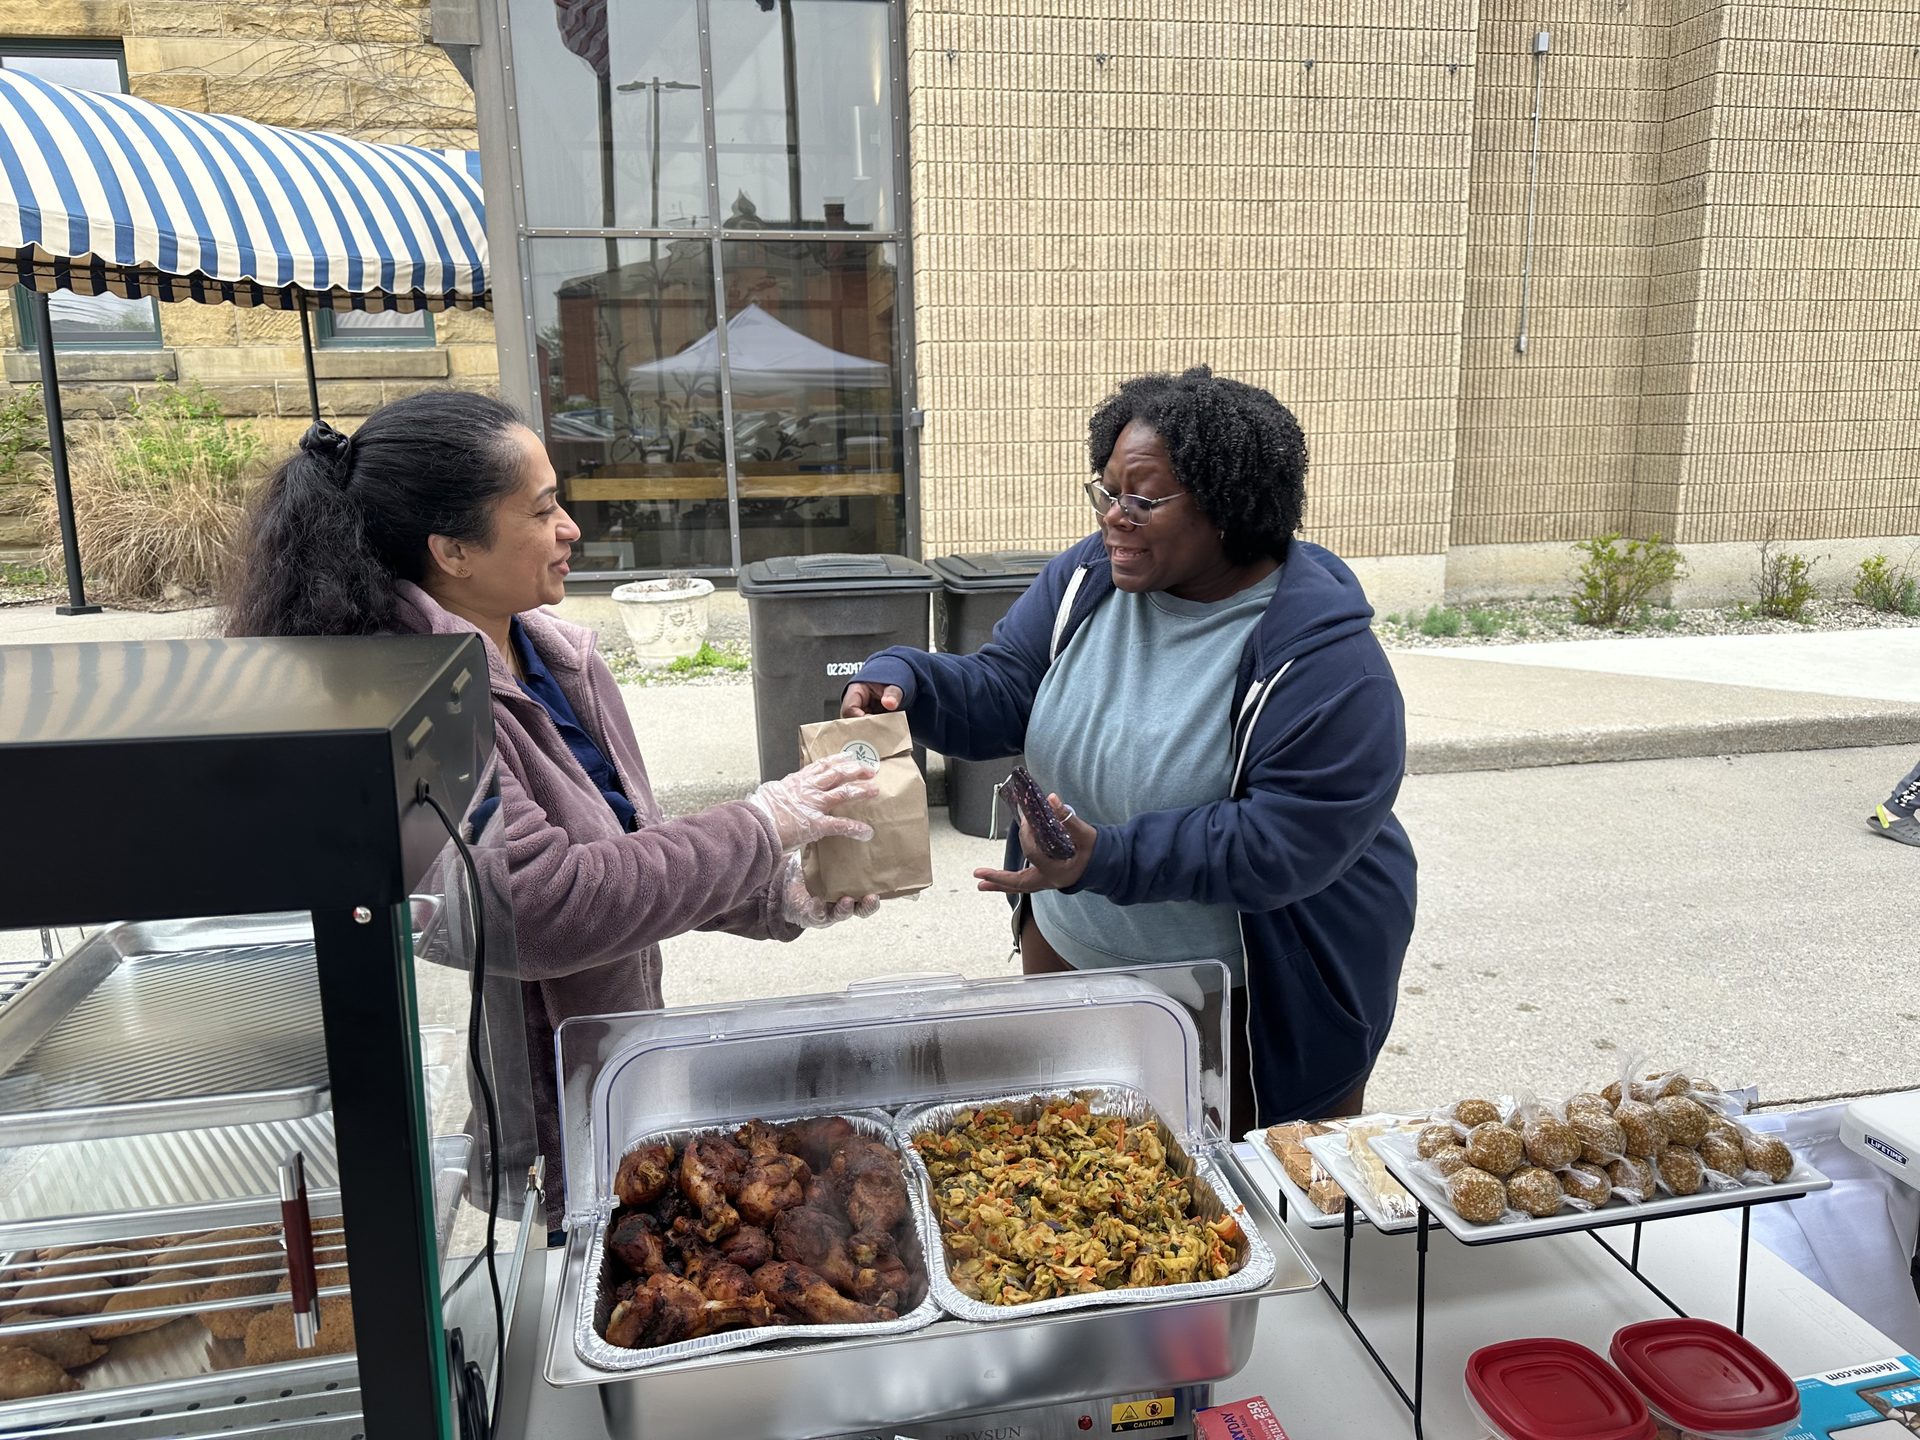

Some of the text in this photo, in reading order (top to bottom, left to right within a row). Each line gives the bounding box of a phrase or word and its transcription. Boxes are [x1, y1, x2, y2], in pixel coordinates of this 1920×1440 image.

[1870, 1139, 1904, 1163] LIFETIME
[1825, 1361, 1900, 1381] lifetime.com
[1247, 1402, 1266, 1420] 250
[1133, 1419, 1164, 1429] CAUTION
